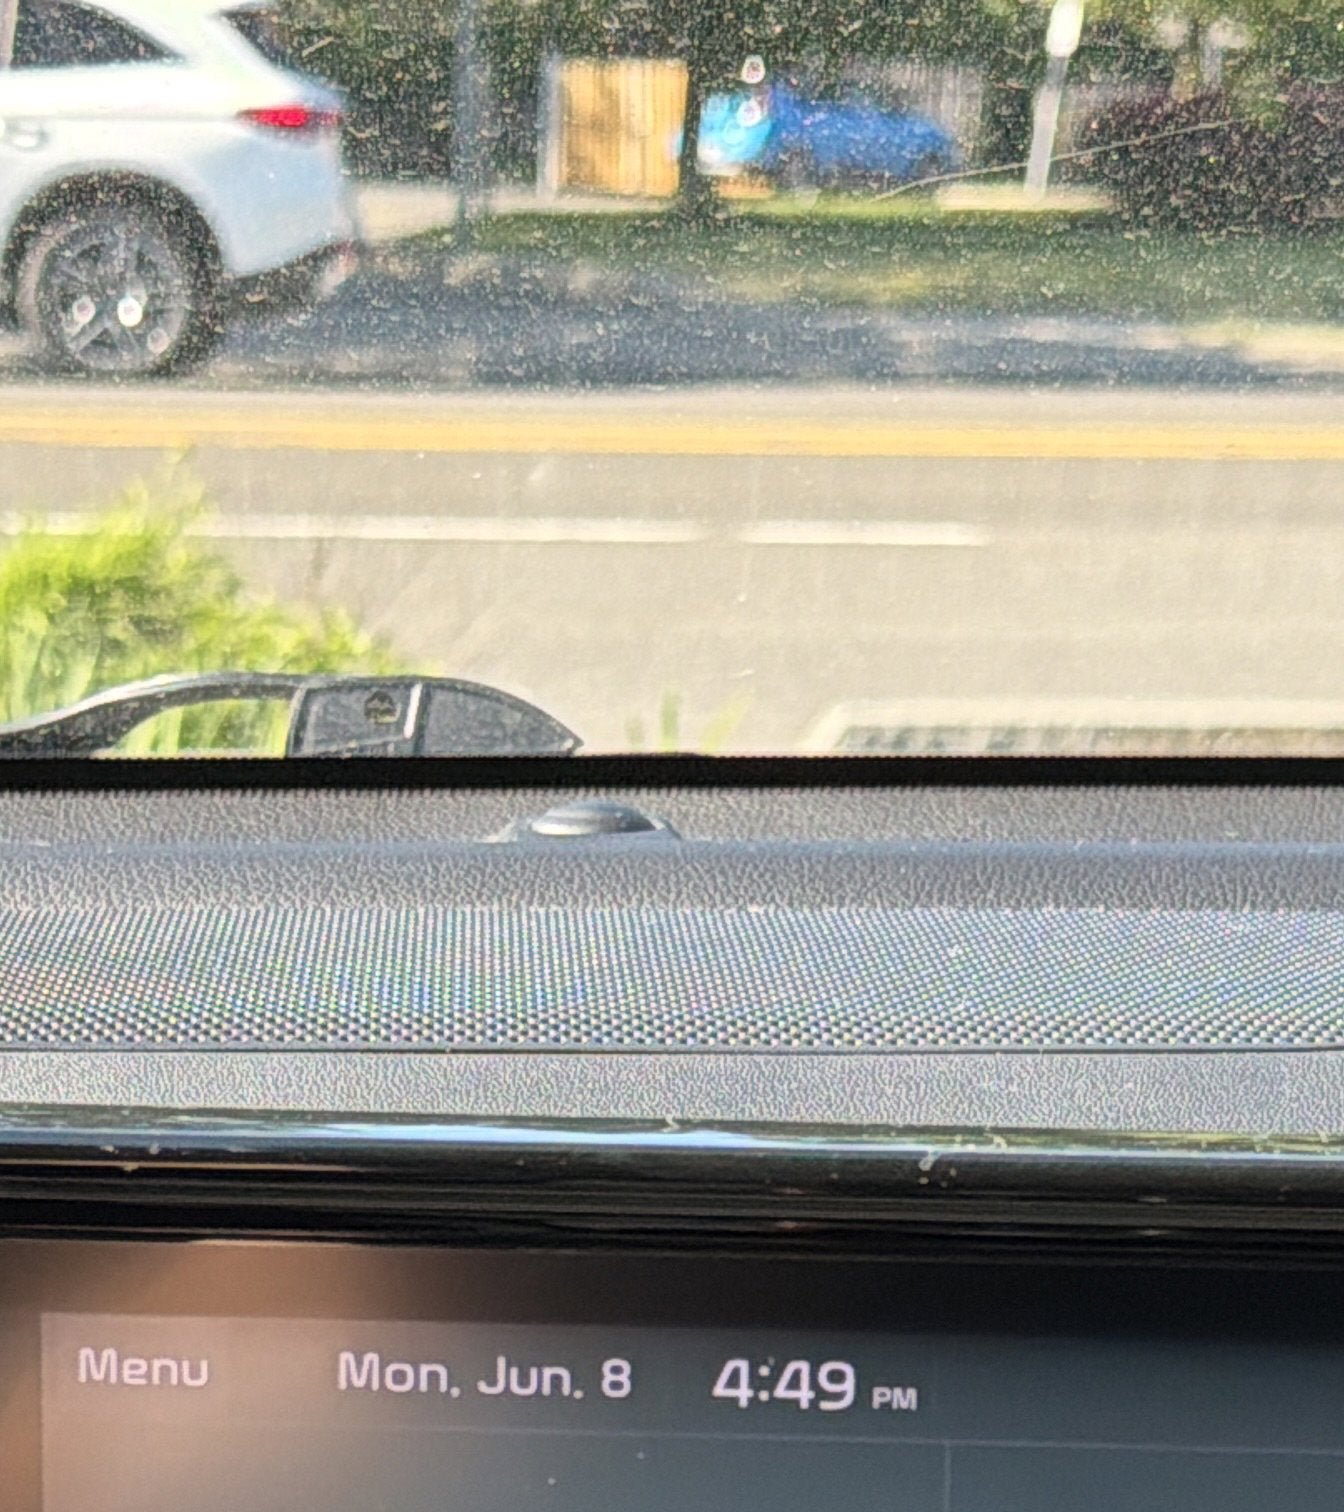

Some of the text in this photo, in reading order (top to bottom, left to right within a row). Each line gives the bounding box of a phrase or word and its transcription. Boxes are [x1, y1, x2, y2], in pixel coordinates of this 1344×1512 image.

[79, 1348, 208, 1386] Menu
[338, 1351, 630, 1398] Mon. Jun. 8
[713, 1359, 917, 1410] 4:49 PM
